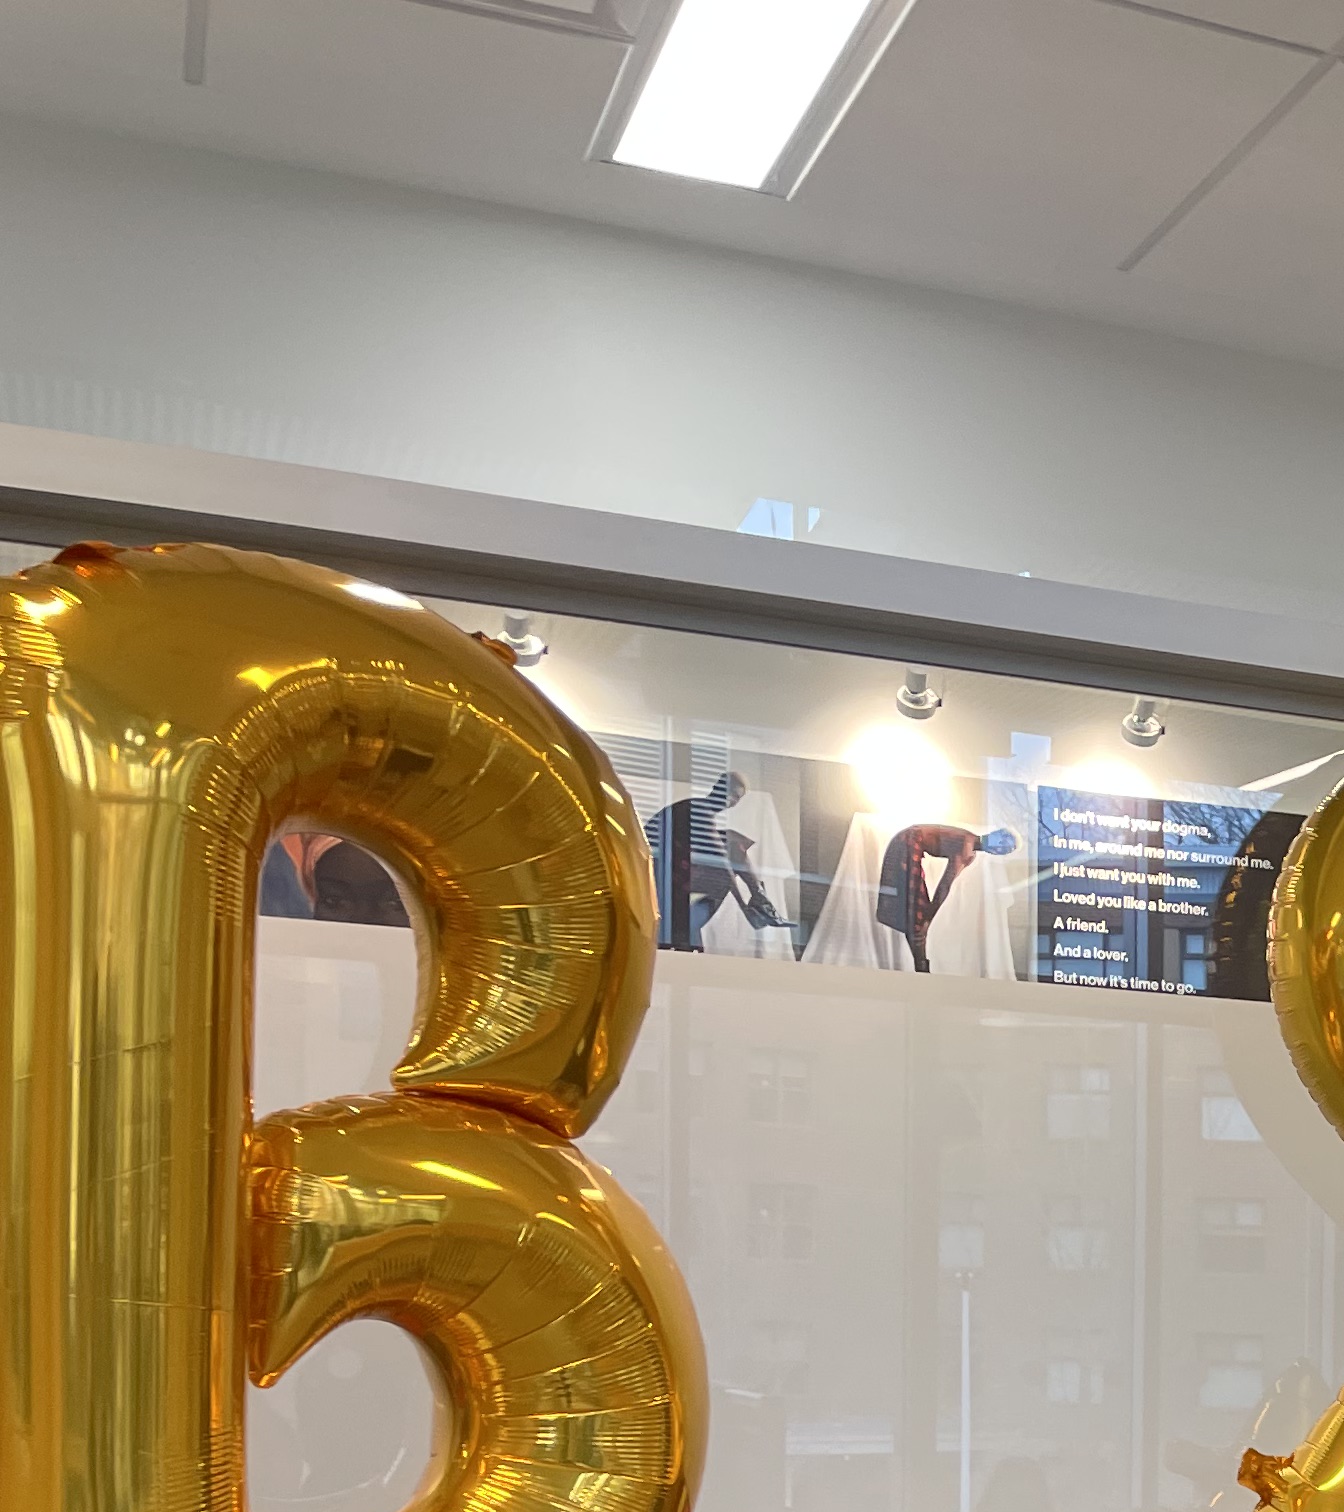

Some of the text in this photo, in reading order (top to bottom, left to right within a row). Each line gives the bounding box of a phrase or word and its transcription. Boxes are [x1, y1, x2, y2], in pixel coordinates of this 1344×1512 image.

[1053, 808, 1211, 838] I don't want your dogma,
[1053, 835, 1274, 870] In me, around me nor surround me.
[1053, 862, 1201, 889] I just want you with me.
[1053, 889, 1209, 916] Loved you like a brother.
[1053, 916, 1109, 933] A friend.
[1053, 943, 1129, 962] And a lover.
[1053, 970, 1196, 995] But now it's time to go.
